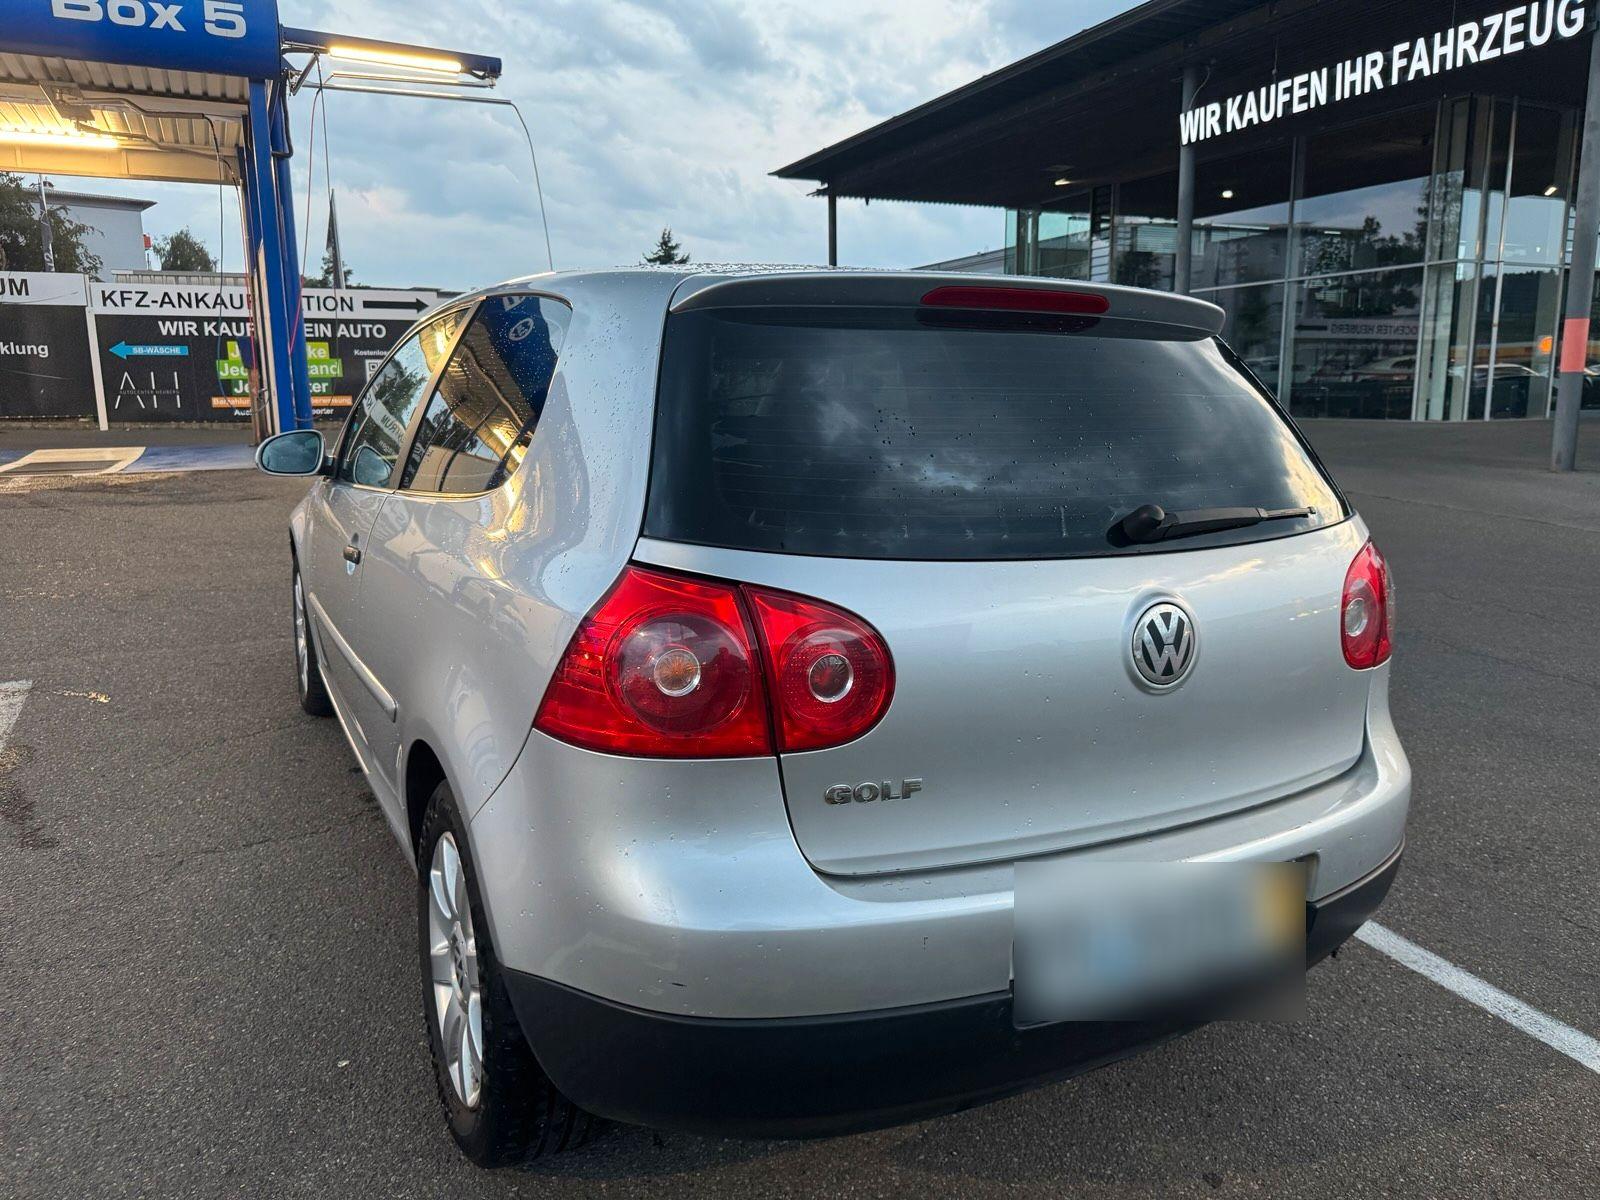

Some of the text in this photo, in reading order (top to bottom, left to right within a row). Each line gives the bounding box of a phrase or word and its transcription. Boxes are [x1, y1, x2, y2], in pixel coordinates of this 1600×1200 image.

[51, 0, 248, 38] Box 5
[1179, 0, 1586, 146] WIR KAUFEN IHR FAHRZEUG
[301, 295, 354, 312] TION
[158, 320, 387, 339] WIR KAUF EIN AUTO
[823, 777, 924, 806] GOLF
